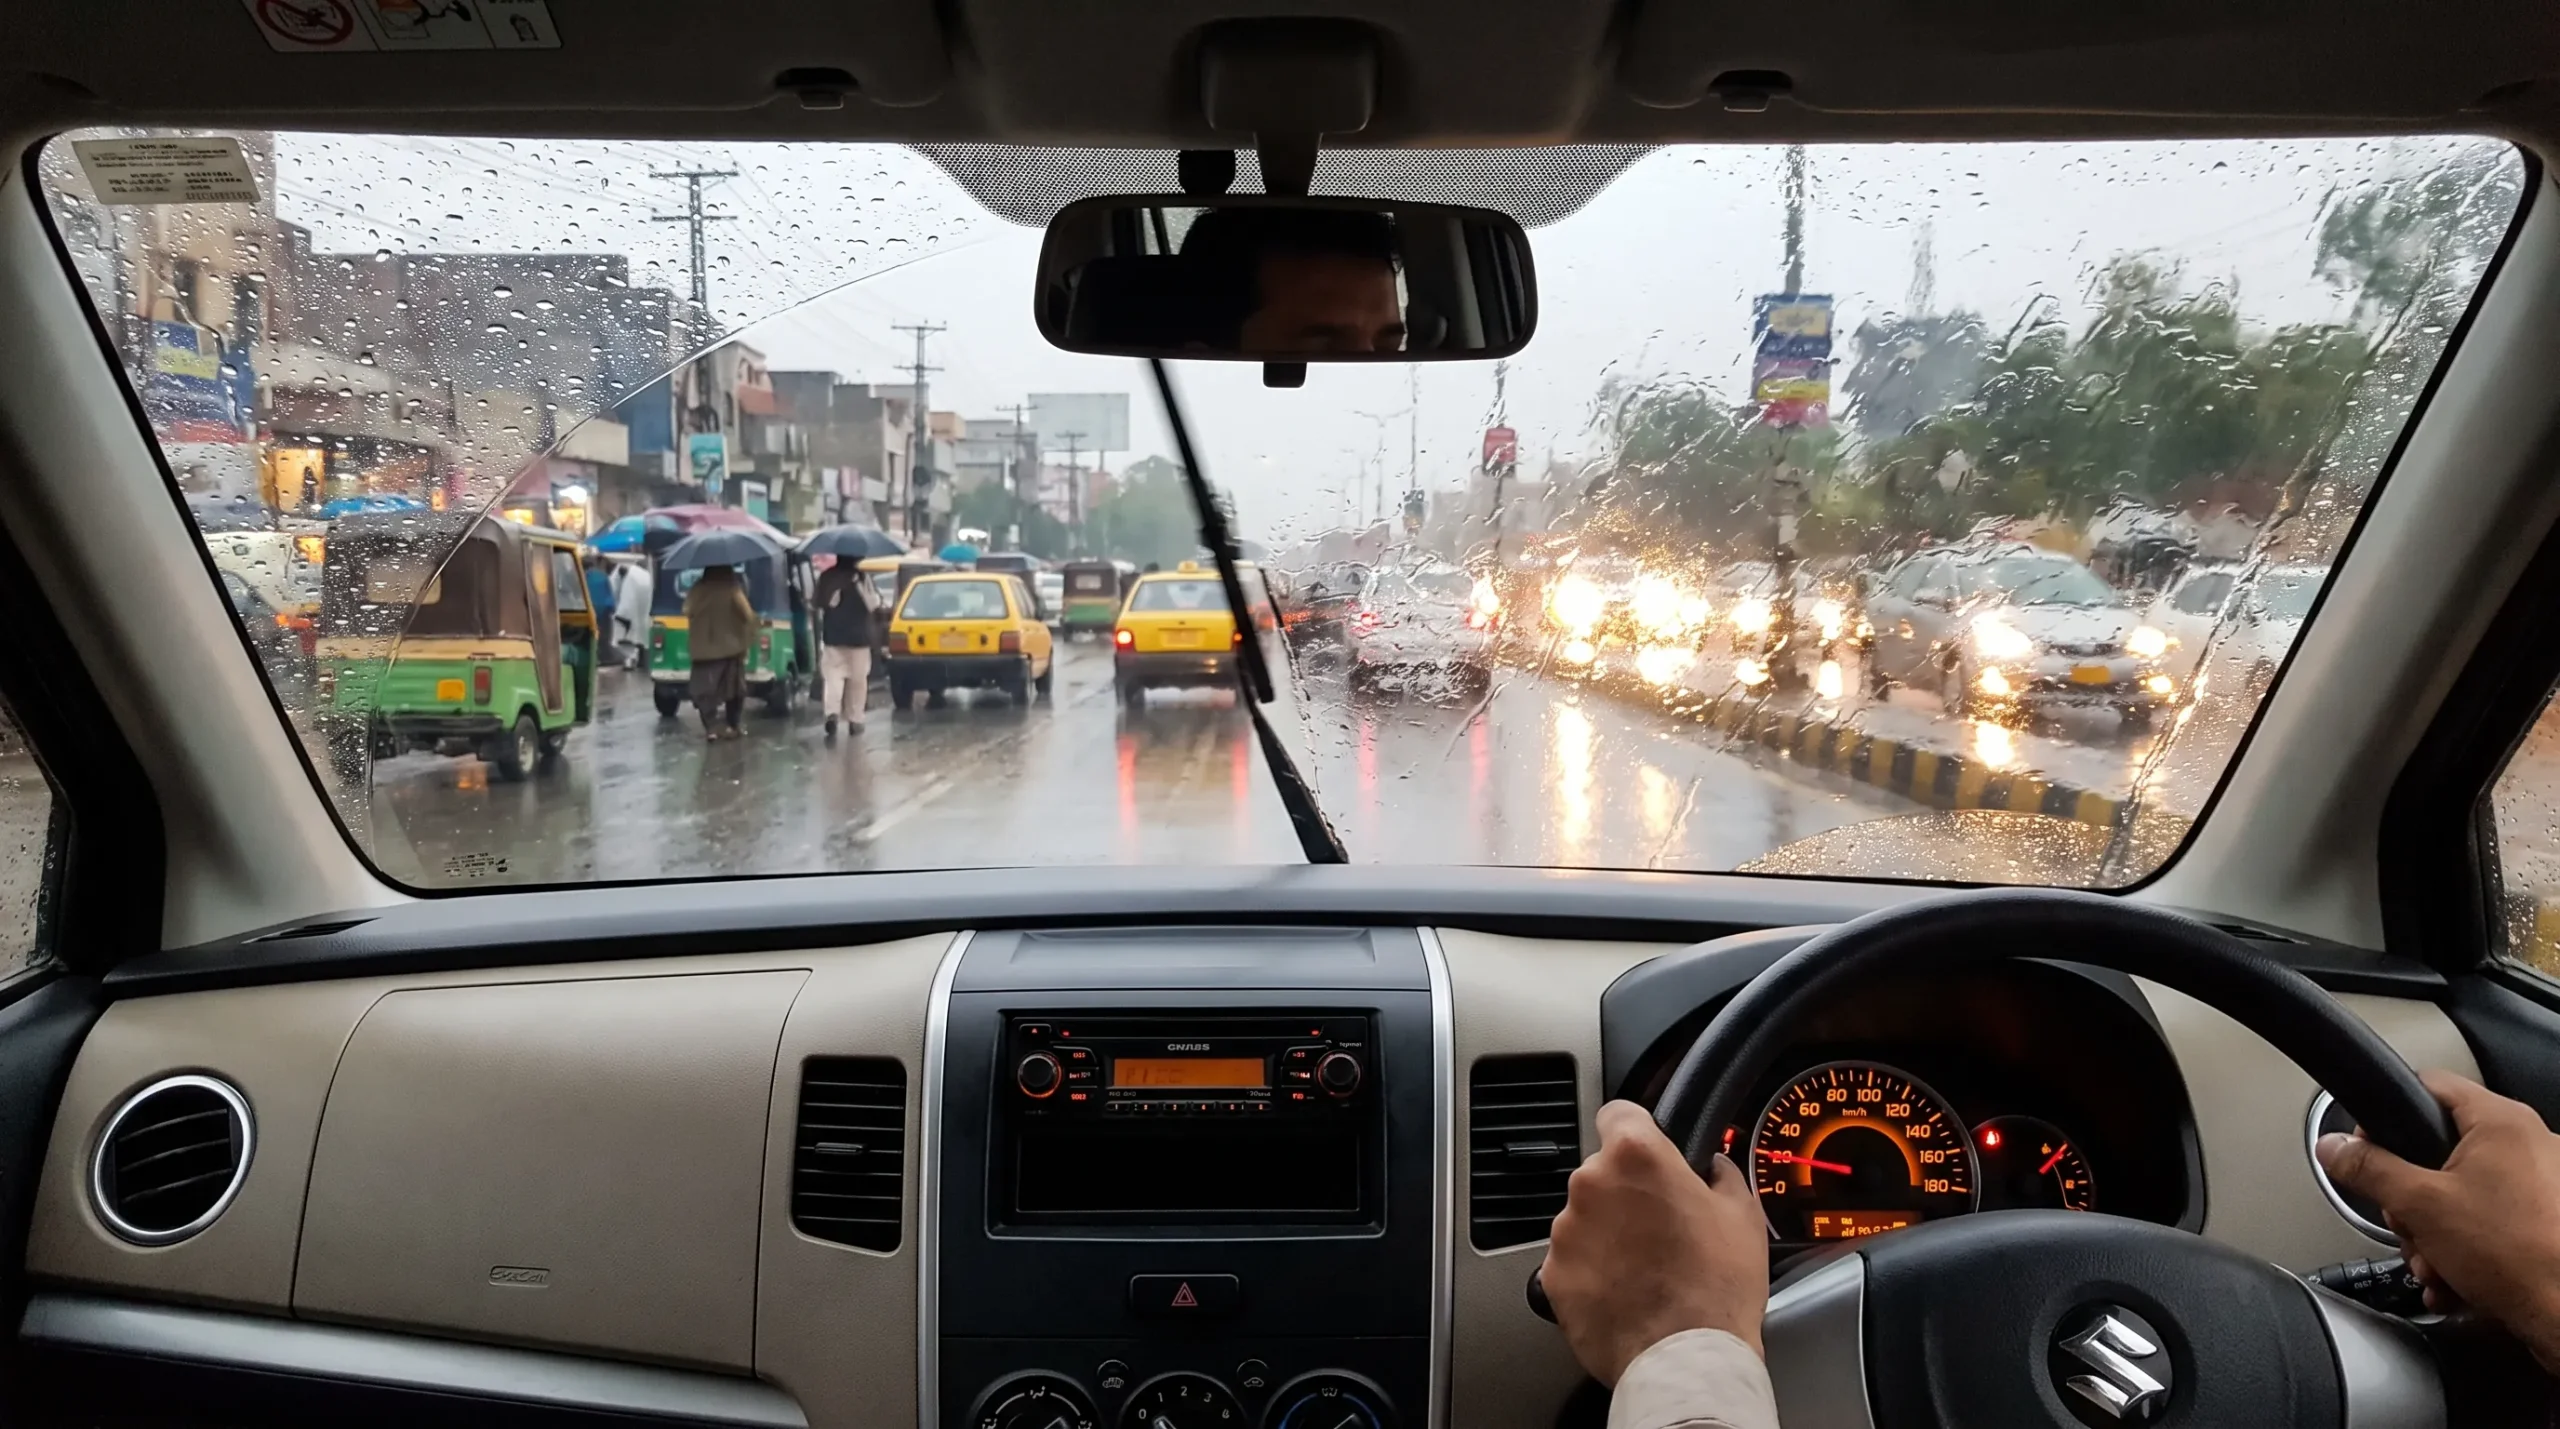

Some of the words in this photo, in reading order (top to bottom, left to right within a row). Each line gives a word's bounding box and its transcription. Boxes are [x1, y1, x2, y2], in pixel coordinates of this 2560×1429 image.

[1826, 1089, 1847, 1102] 80
[1857, 1089, 1881, 1102] 100
[1799, 1103, 1820, 1116] 60
[1886, 1104, 1910, 1117] 120
[1779, 1124, 1800, 1137] 40
[1906, 1125, 1931, 1138] 140
[1772, 1150, 1793, 1164] 20
[1920, 1150, 1944, 1163] 160
[1775, 1181, 1786, 1194] 0
[1924, 1180, 1949, 1193] 180
[1158, 1392, 1163, 1403] 1
[1180, 1386, 1187, 1396] 2
[1203, 1392, 1212, 1402] 3
[1138, 1408, 1147, 1420] 0
